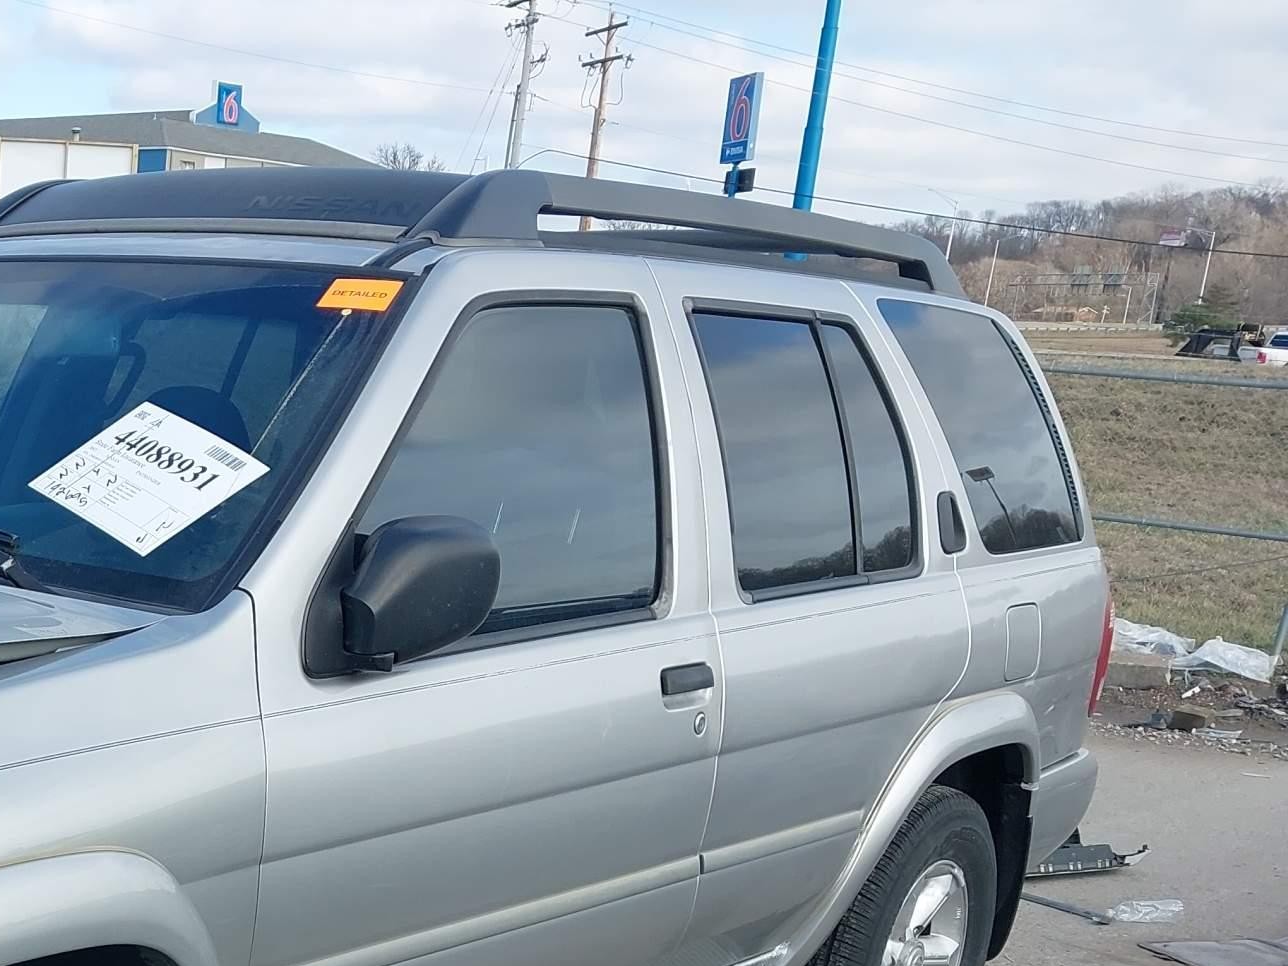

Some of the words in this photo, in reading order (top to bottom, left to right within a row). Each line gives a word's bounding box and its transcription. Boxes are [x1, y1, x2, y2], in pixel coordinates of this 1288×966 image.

[223, 91, 239, 124] 6
[730, 77, 750, 141] 6
[332, 290, 388, 299] DETAILED
[114, 430, 220, 492] 44088931
